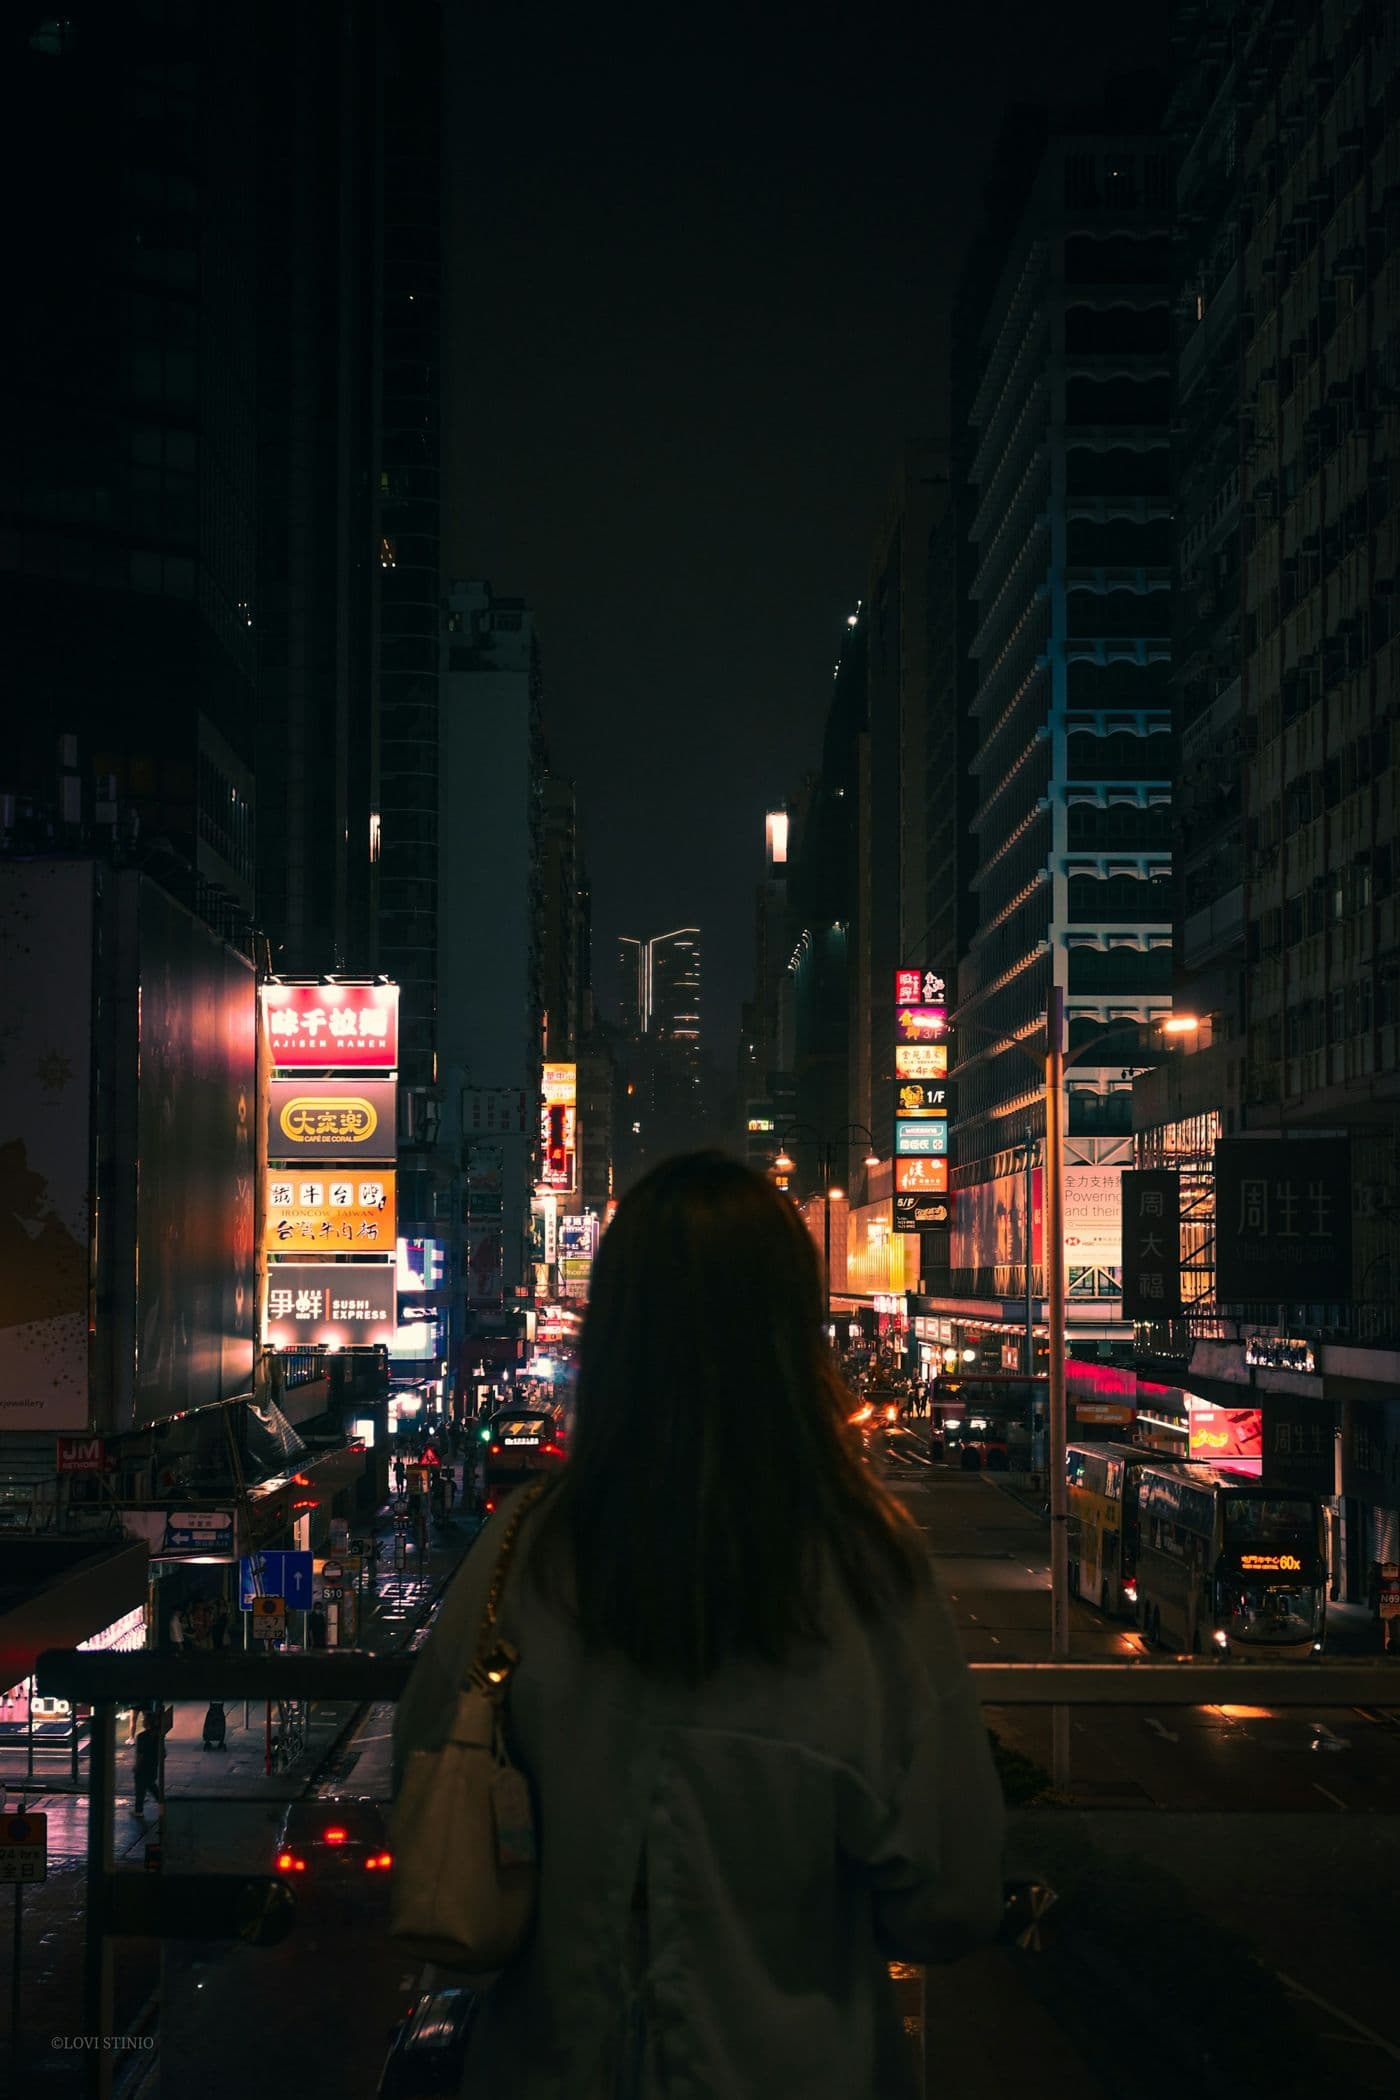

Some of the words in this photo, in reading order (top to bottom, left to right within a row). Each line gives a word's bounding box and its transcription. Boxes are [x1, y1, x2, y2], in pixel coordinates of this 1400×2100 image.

[273, 1040, 327, 1048] AJISEN
[337, 1040, 386, 1048] RAMEN
[926, 1090, 946, 1104] 1/F
[1065, 1206, 1088, 1217] and
[1237, 1179, 1334, 1237] 周生生
[1138, 1191, 1166, 1299] 周大福
[332, 1300, 370, 1310] SUSHI
[332, 1310, 388, 1320] EXPRESS
[63, 1440, 101, 1460] JM
[323, 1589, 343, 1599] S10
